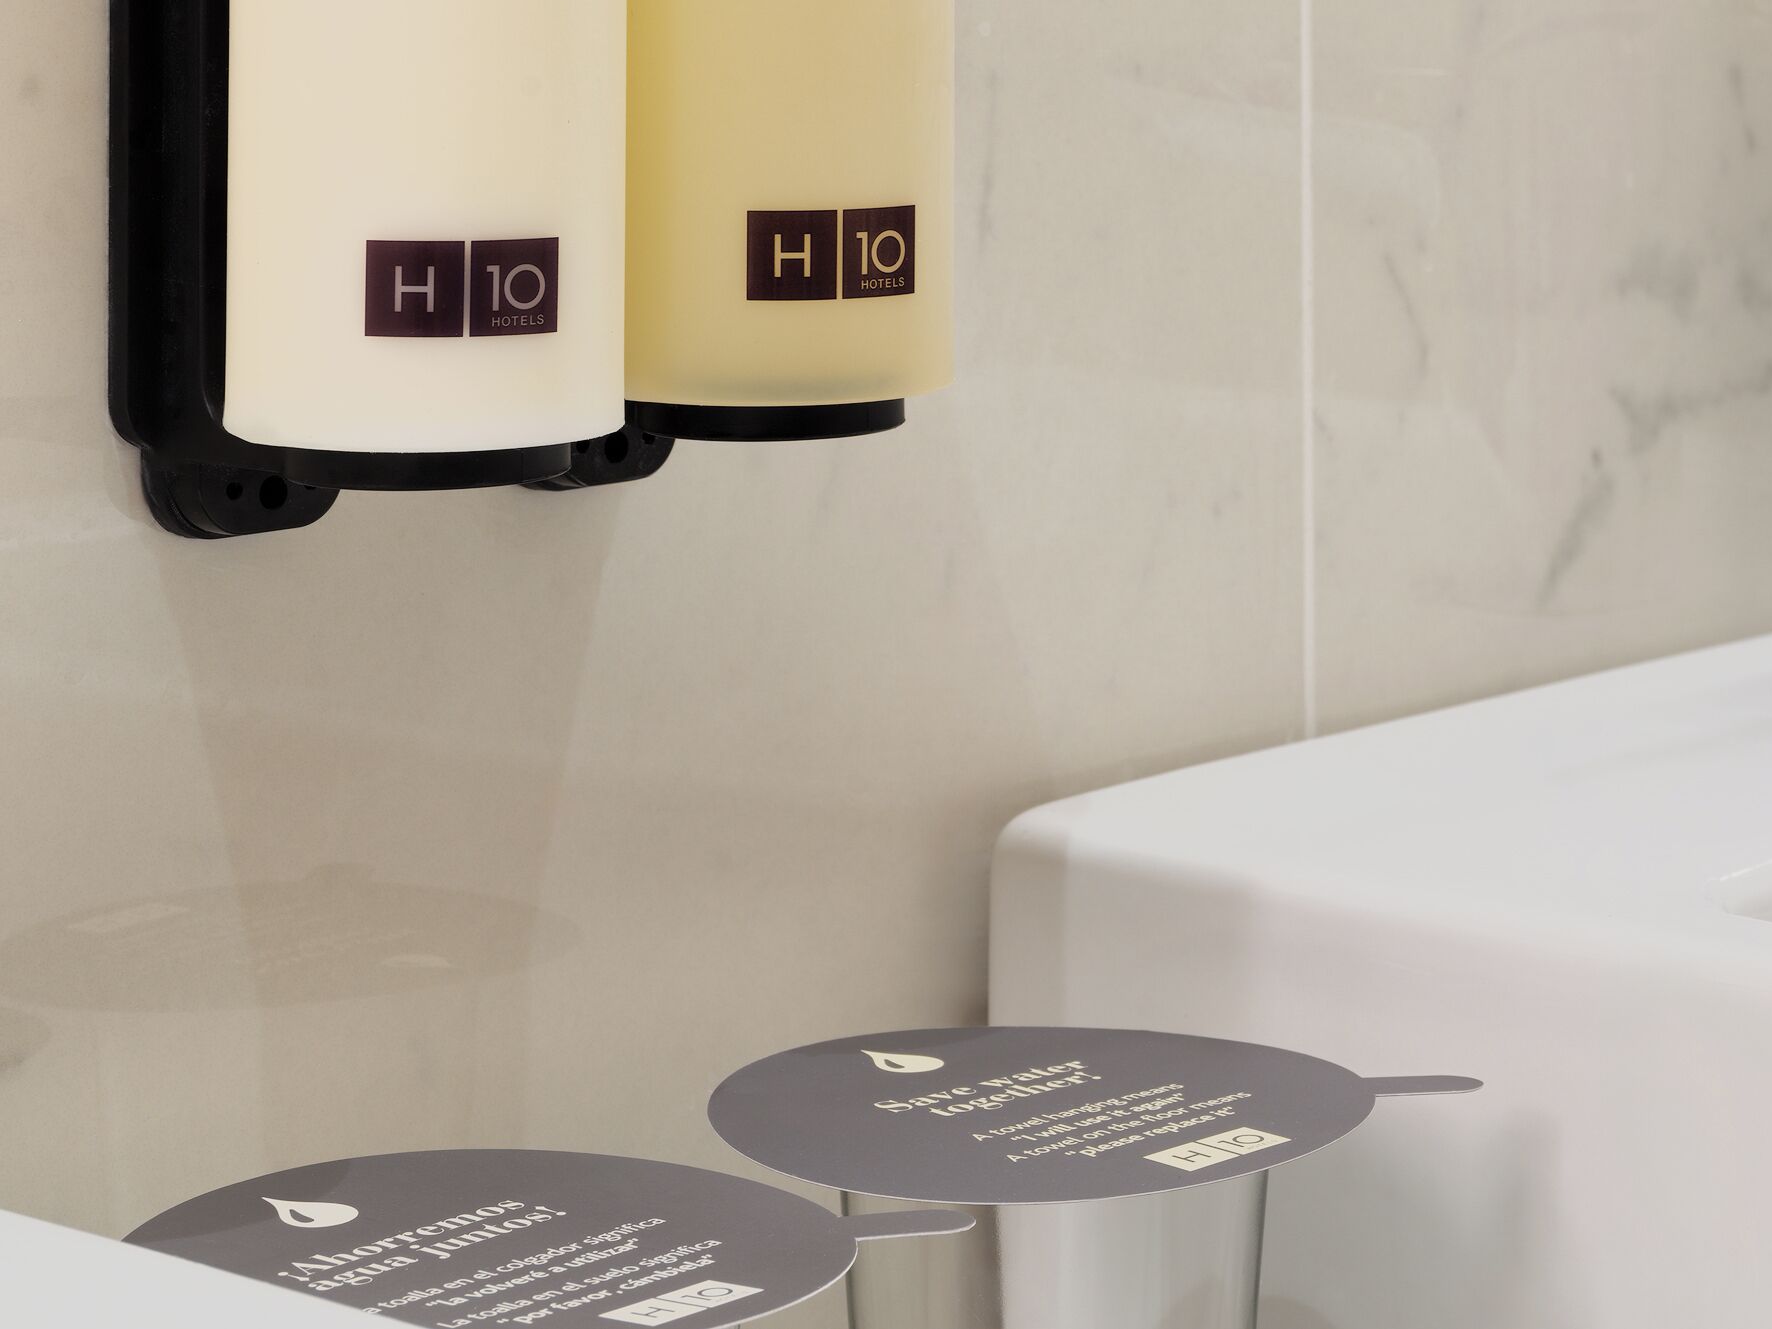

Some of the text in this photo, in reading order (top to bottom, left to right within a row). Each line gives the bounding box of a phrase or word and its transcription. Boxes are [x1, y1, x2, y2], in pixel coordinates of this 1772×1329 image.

[773, 229, 906, 278] H 10
[394, 263, 546, 313] H 10
[857, 276, 905, 290] HOTELS
[491, 314, 545, 328] HOTELS
[873, 1060, 1088, 1113] Save water
[928, 1071, 1102, 1117] together!
[972, 1083, 1184, 1142] A towel hanging means
[1006, 1091, 1252, 1163] A towel on the floor means
[1033, 1123, 1077, 1139] will
[1074, 1115, 1112, 1128] use
[1107, 1109, 1132, 1118] it
[1144, 1113, 1217, 1137] replace
[1171, 1150, 1212, 1163] H
[1217, 1134, 1265, 1148] 10
[277, 1199, 525, 1282] ¡Ahorremos
[307, 1205, 567, 1291] agua juntos!
[377, 1286, 445, 1309] toalla
[442, 1277, 475, 1289] en
[472, 1270, 499, 1280] el
[496, 1242, 583, 1273] colgador
[583, 1218, 667, 1245] significa
[436, 1239, 723, 1329] La toalla en el suelo significa
[464, 1270, 550, 1298] volveré
[547, 1265, 568, 1273] a
[549, 1289, 613, 1310] favor
[631, 1306, 676, 1318] H
